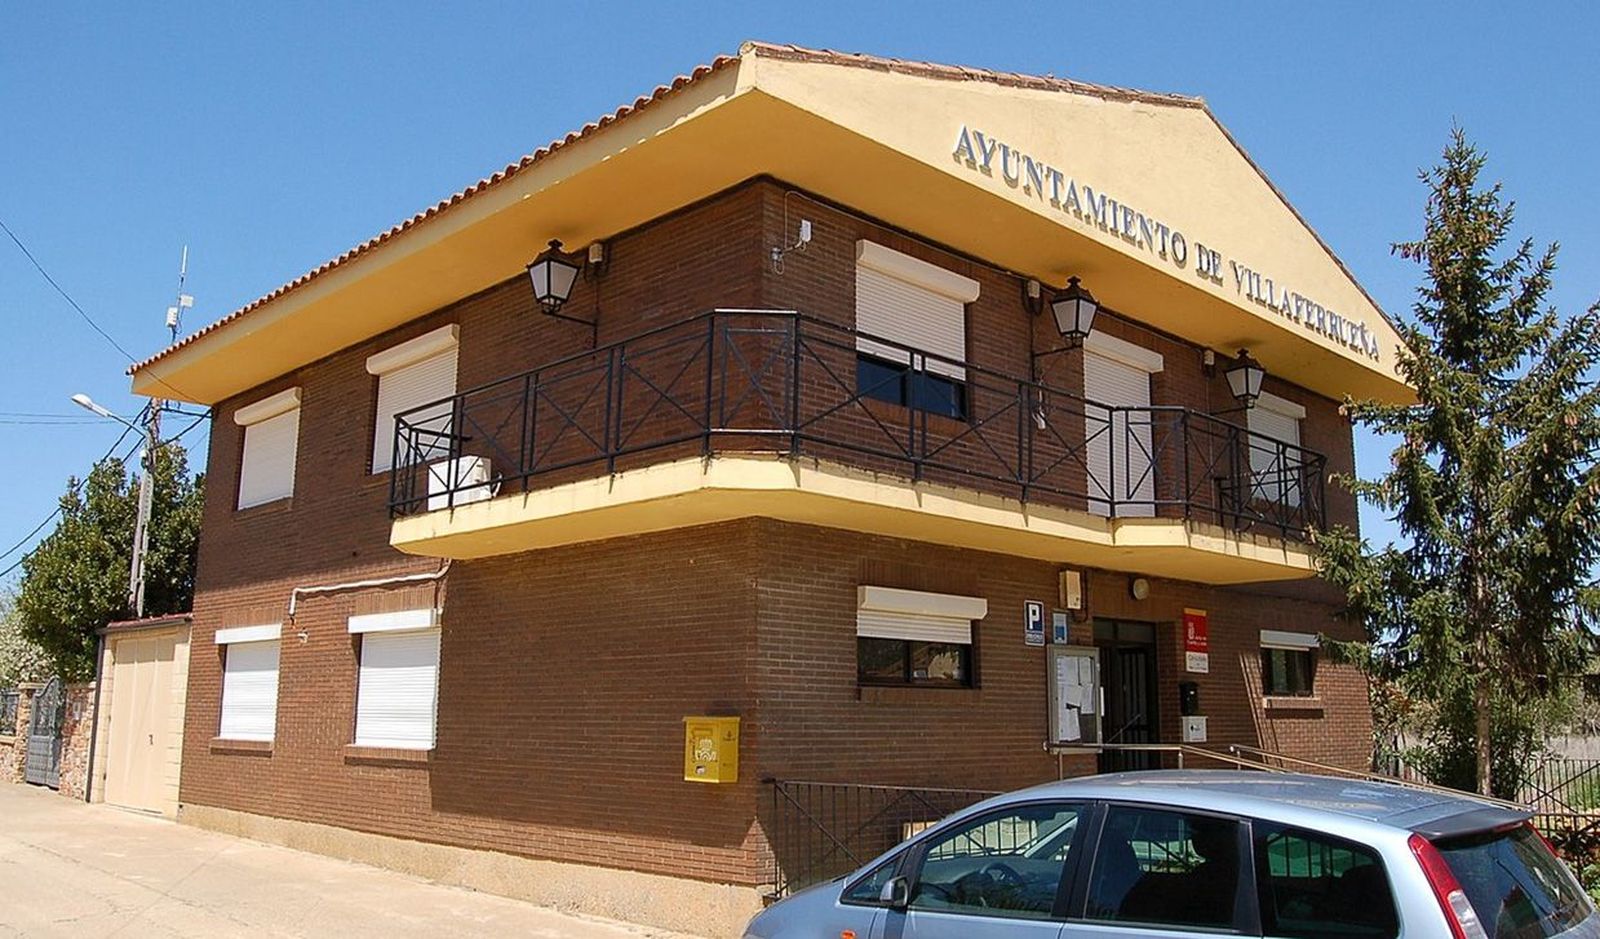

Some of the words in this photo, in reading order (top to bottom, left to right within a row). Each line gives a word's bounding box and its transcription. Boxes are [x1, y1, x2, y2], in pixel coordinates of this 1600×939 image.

[952, 124, 1187, 269] AYUNTAMIENTO
[1195, 242, 1224, 287] DE
[1229, 260, 1380, 362] VILLAFERRUEÑA
[1028, 603, 1041, 630] P
